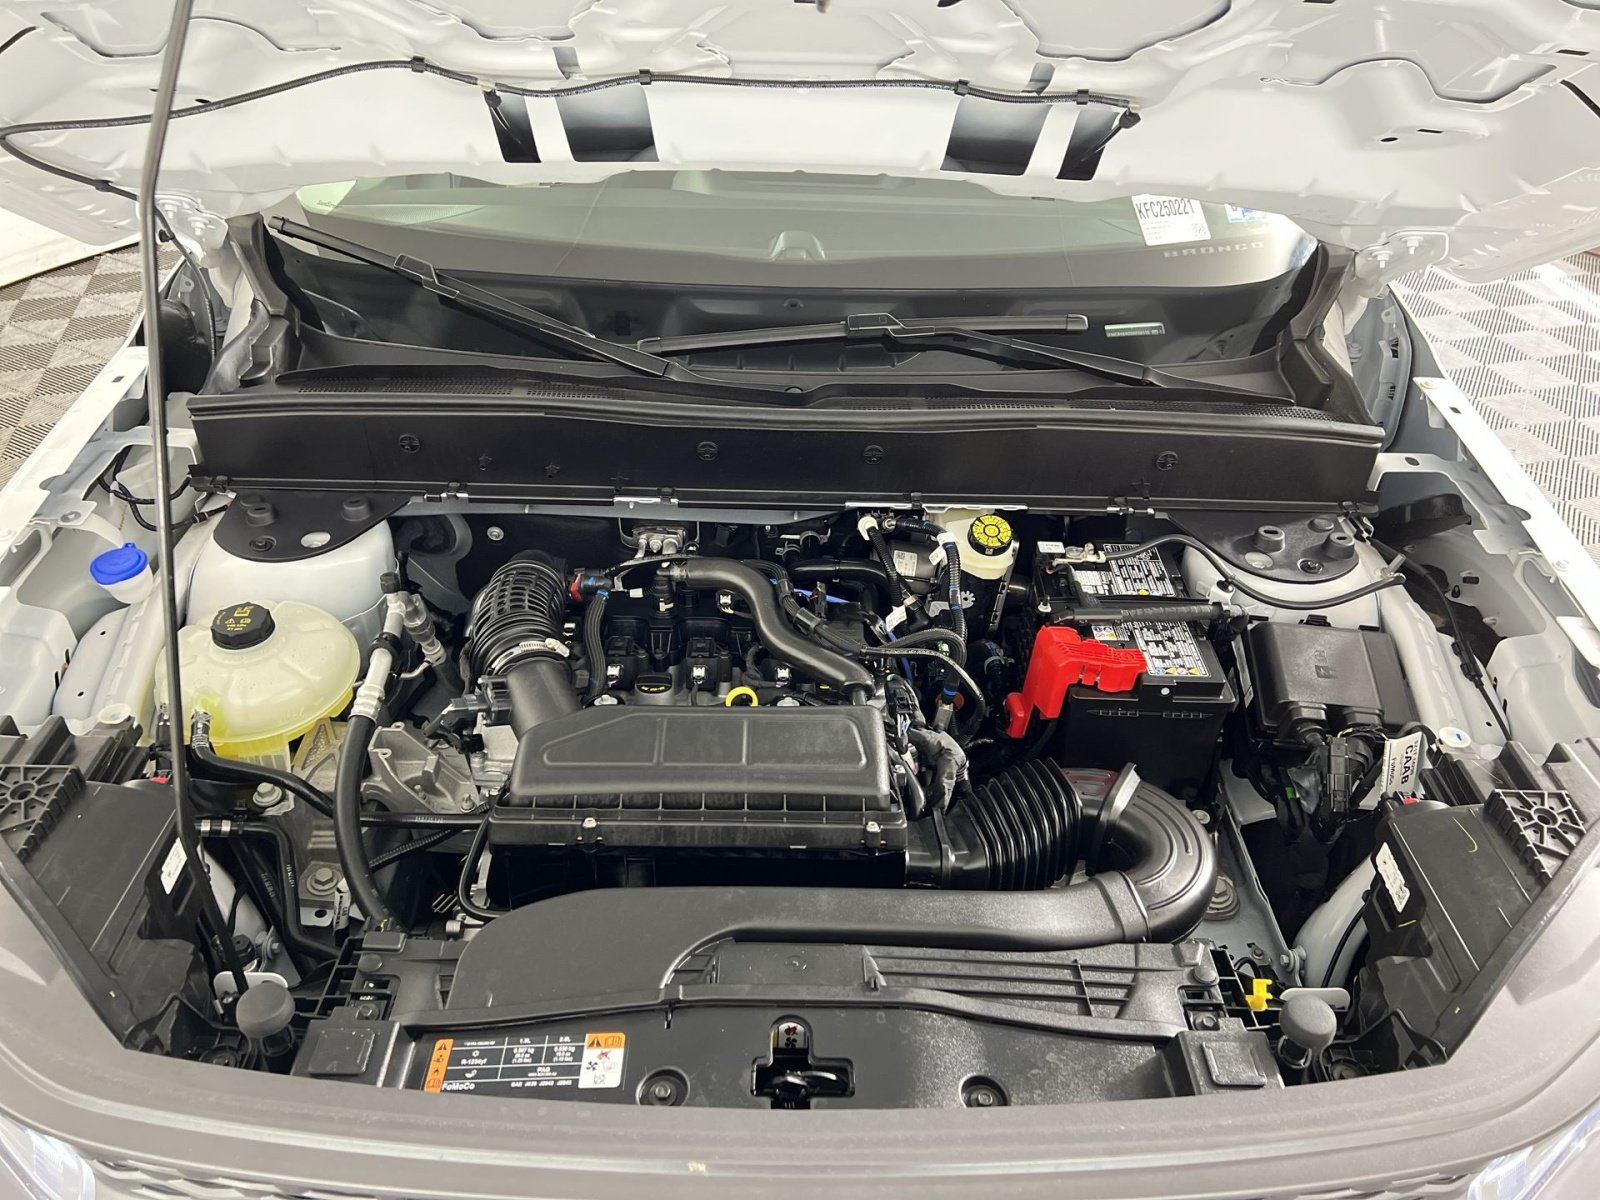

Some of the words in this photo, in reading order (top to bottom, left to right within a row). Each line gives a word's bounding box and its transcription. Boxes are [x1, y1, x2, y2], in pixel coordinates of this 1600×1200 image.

[1135, 198, 1196, 220] KFC250221
[1163, 241, 1264, 258] BRONCO
[1401, 744, 1414, 785] CAAB
[441, 1082, 476, 1091] FoMoCo
